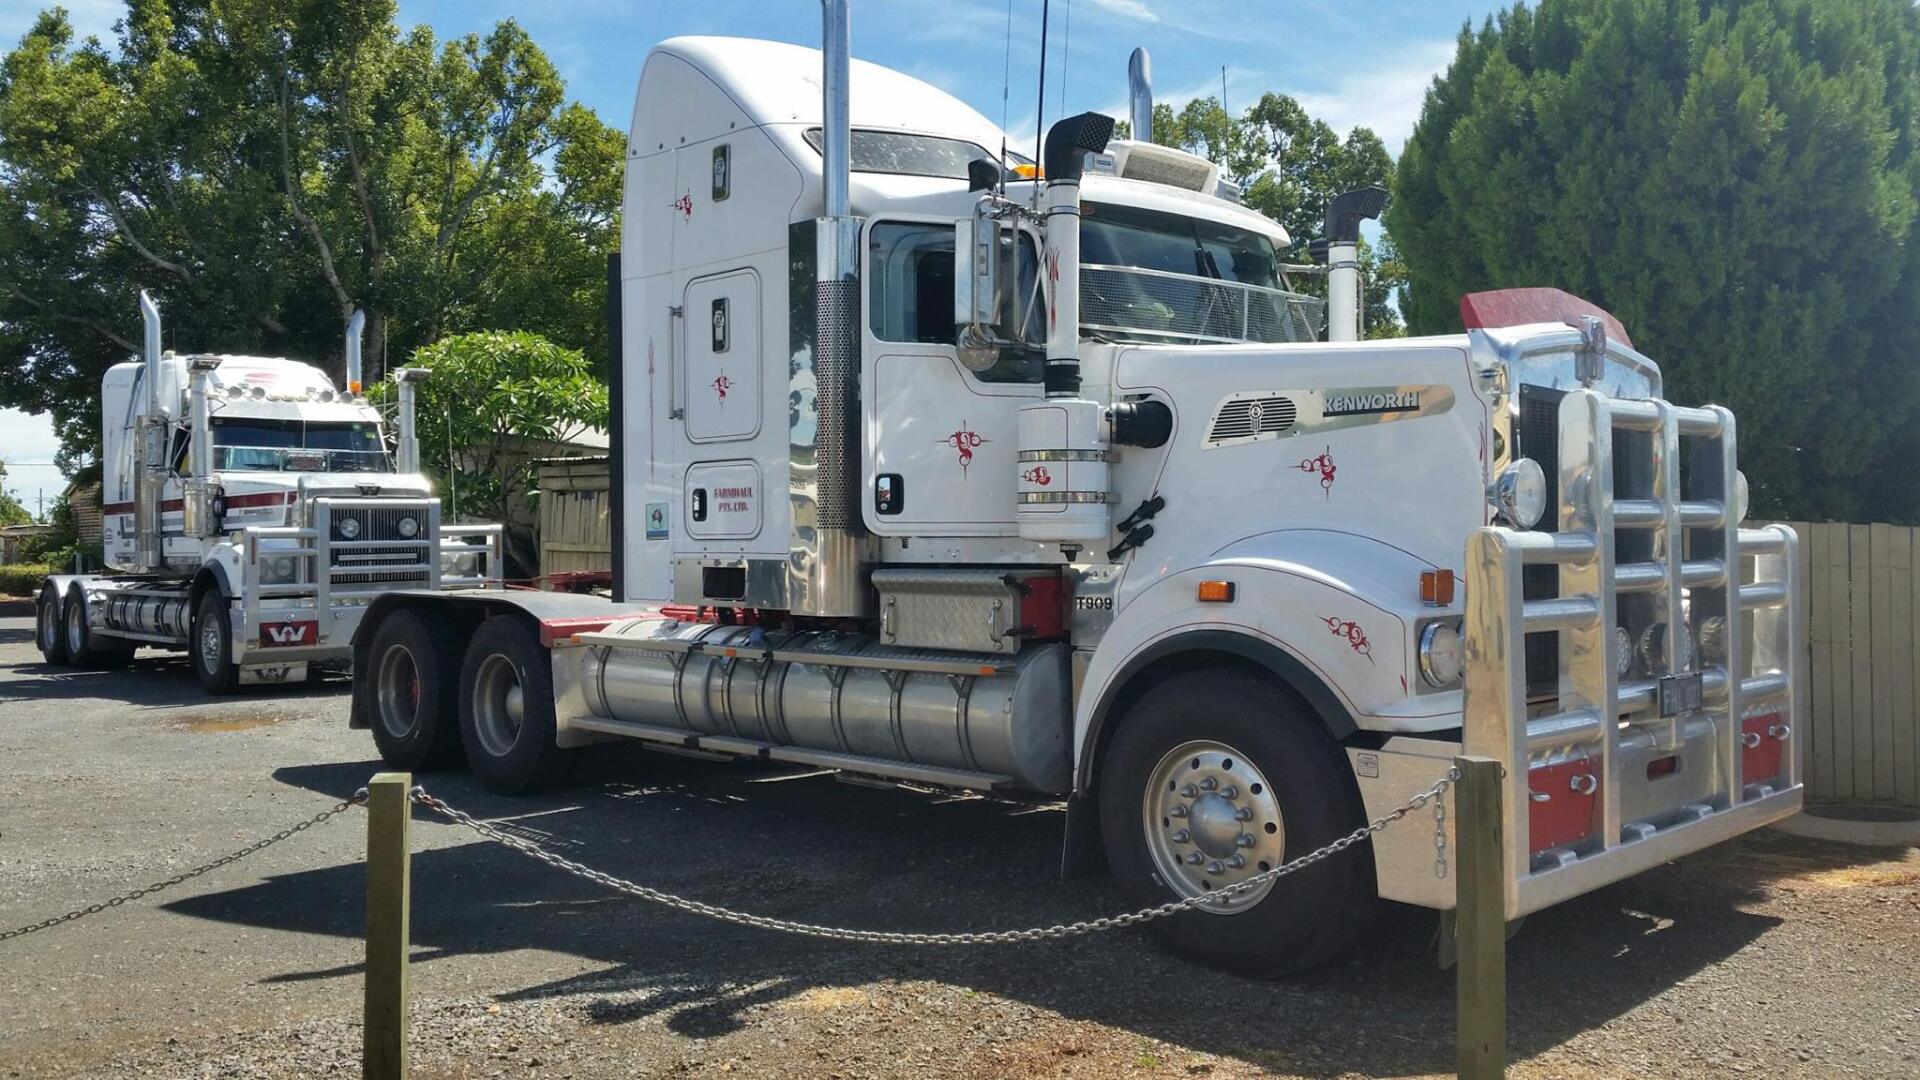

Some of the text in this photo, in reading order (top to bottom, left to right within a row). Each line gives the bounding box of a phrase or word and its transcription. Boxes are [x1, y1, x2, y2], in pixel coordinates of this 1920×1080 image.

[1324, 391, 1420, 413] KENWORTH
[714, 487, 753, 498] FARMHAUL
[1076, 596, 1112, 610] T909
